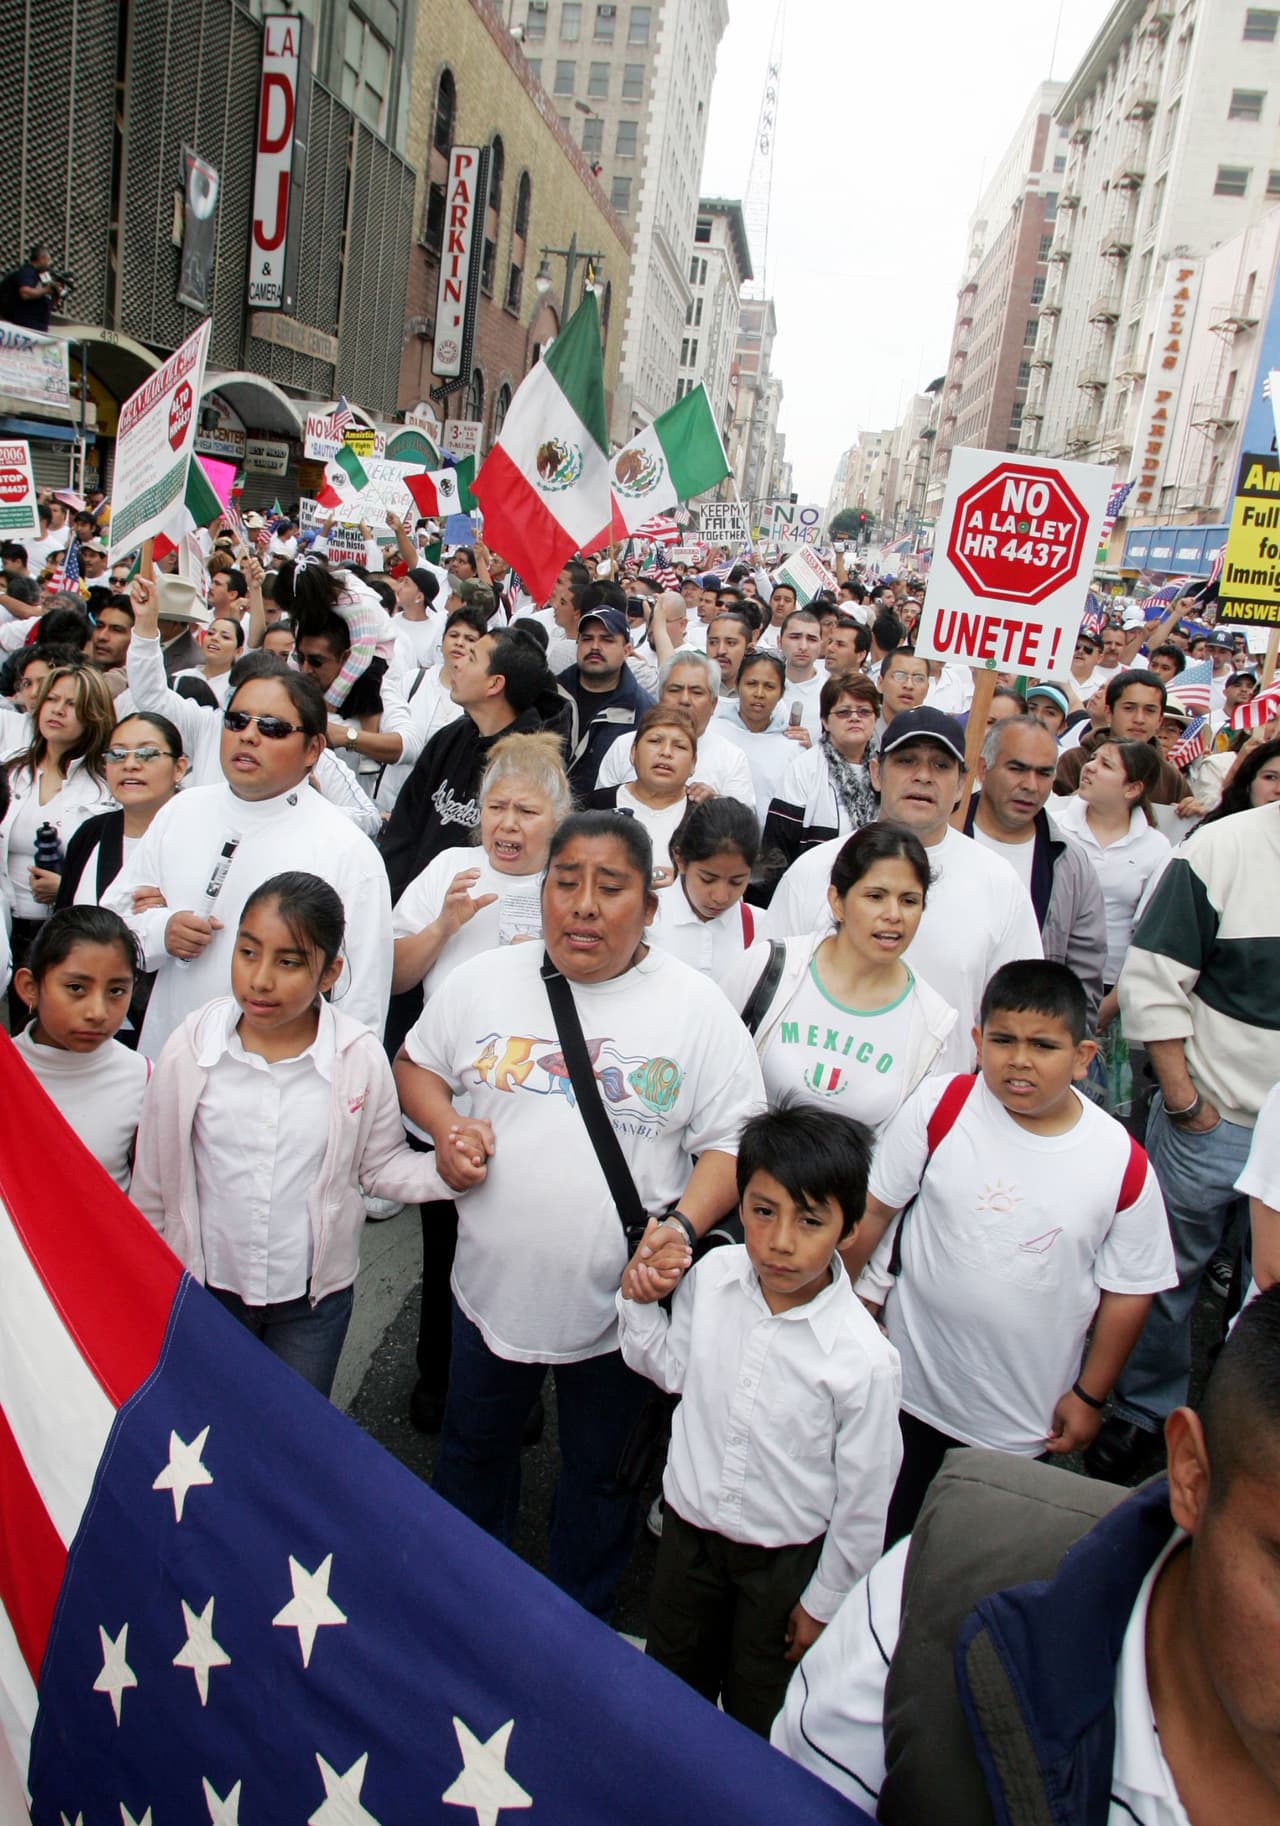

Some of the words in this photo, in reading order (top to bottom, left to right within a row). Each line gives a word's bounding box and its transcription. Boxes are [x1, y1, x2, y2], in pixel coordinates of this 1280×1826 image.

[264, 26, 294, 57] LA
[443, 153, 473, 328] PARKIN
[261, 261, 272, 277] &
[249, 282, 282, 301] CAMERA
[1162, 268, 1194, 370] FALLAS
[101, 329, 120, 344] 430
[213, 426, 244, 445] CENTER
[1136, 390, 1173, 504] PAREDES
[1001, 479, 1050, 517] NO
[772, 523, 821, 544] HR4437
[968, 510, 984, 529] A
[990, 513, 1016, 533] LA
[1029, 518, 1072, 541] LEY
[964, 532, 998, 559] HR
[1000, 538, 1067, 569] 4437
[1259, 537, 1280, 559] fo
[932, 608, 1043, 668] UNETE
[781, 1021, 893, 1074] MEXICO
